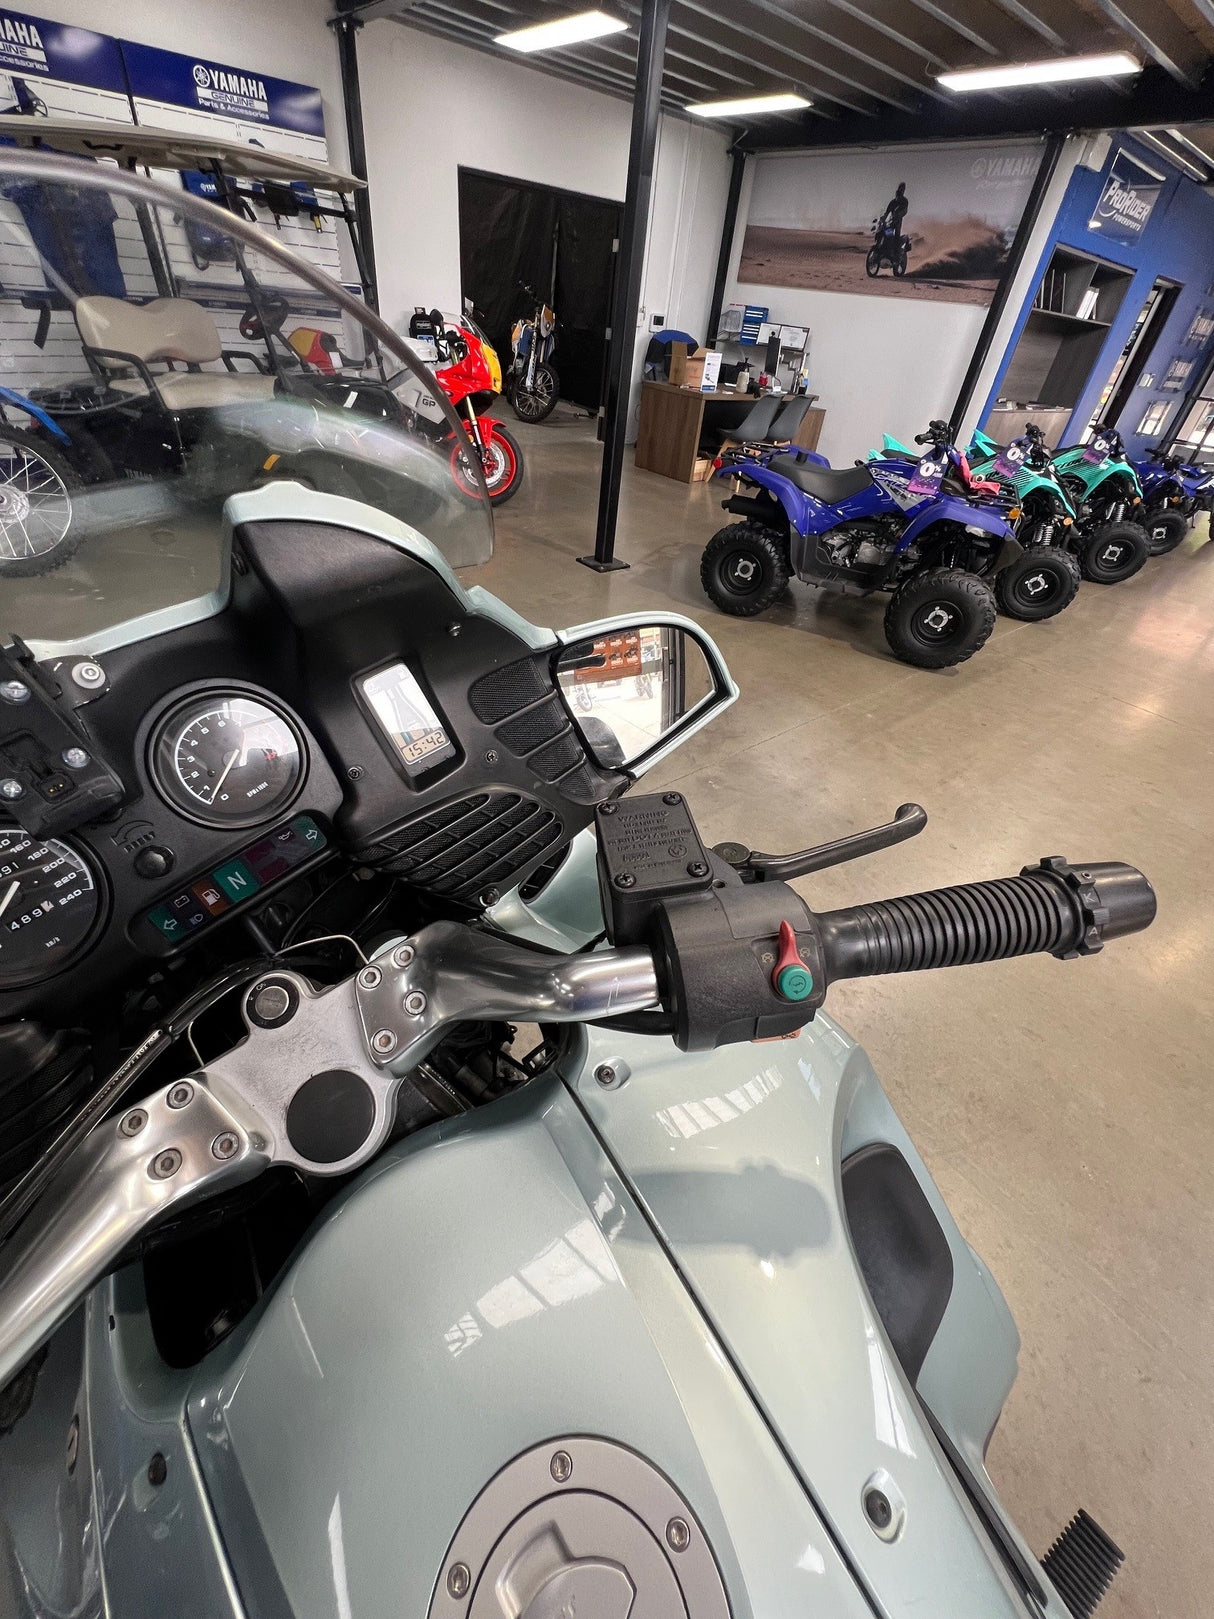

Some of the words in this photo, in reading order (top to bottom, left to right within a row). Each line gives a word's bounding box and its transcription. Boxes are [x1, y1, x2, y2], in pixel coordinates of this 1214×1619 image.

[0, 18, 44, 49] AHA
[209, 69, 268, 101] YAMAHA
[211, 92, 256, 108] GENUINE
[198, 97, 219, 110] Parts
[227, 104, 270, 120] Accessories
[422, 398, 436, 407] GP
[408, 731, 444, 757] 15:42
[187, 755, 195, 763] 3
[190, 771, 200, 779] 2
[220, 793, 229, 801] 0
[10, 840, 31, 853] 160
[28, 847, 49, 860] 180
[42, 857, 65, 873] 200
[54, 872, 77, 888] 220
[226, 871, 247, 890] N
[59, 889, 82, 905] 240
